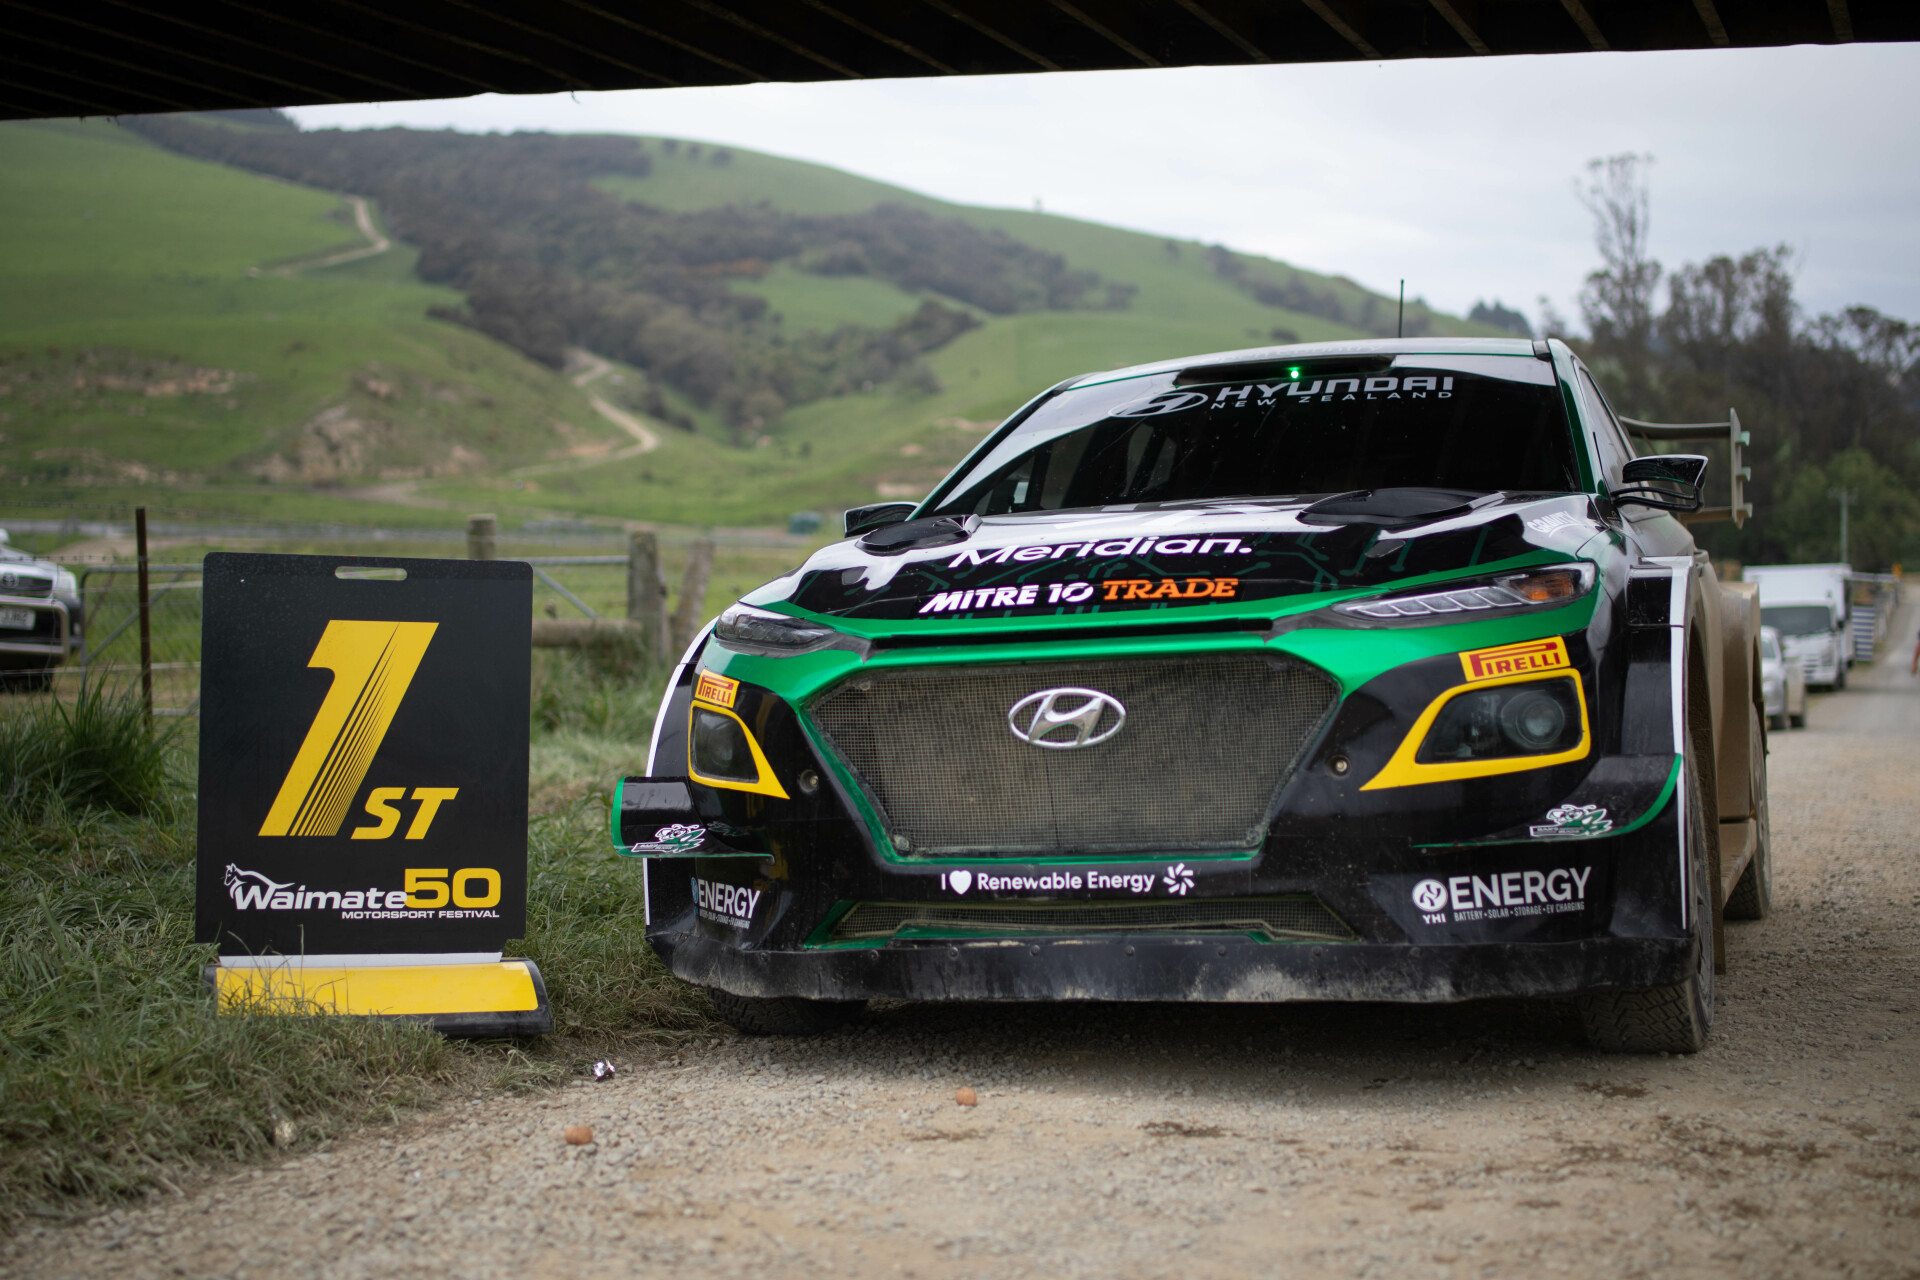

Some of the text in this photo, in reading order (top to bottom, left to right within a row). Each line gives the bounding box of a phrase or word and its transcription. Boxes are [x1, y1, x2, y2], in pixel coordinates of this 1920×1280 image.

[1210, 391, 1453, 410] NEW ZEALAND
[1215, 377, 1454, 401] HYUNDAI
[948, 537, 1252, 568] Meridian.
[918, 578, 1239, 614] MITRE 10 TRADE
[1469, 642, 1562, 678] PIRELLI
[698, 674, 735, 705] PIRELLI
[941, 871, 1155, 893] I Renewable Energy
[1449, 866, 1592, 910] ENERGY
[697, 878, 761, 919] ENERGY
[1453, 901, 1585, 922] BATTERY SOLAR STORAGE EV CHARGING
[341, 910, 500, 920] MOTORSPORT FESTIVAL
[1422, 913, 1447, 924] YHI
